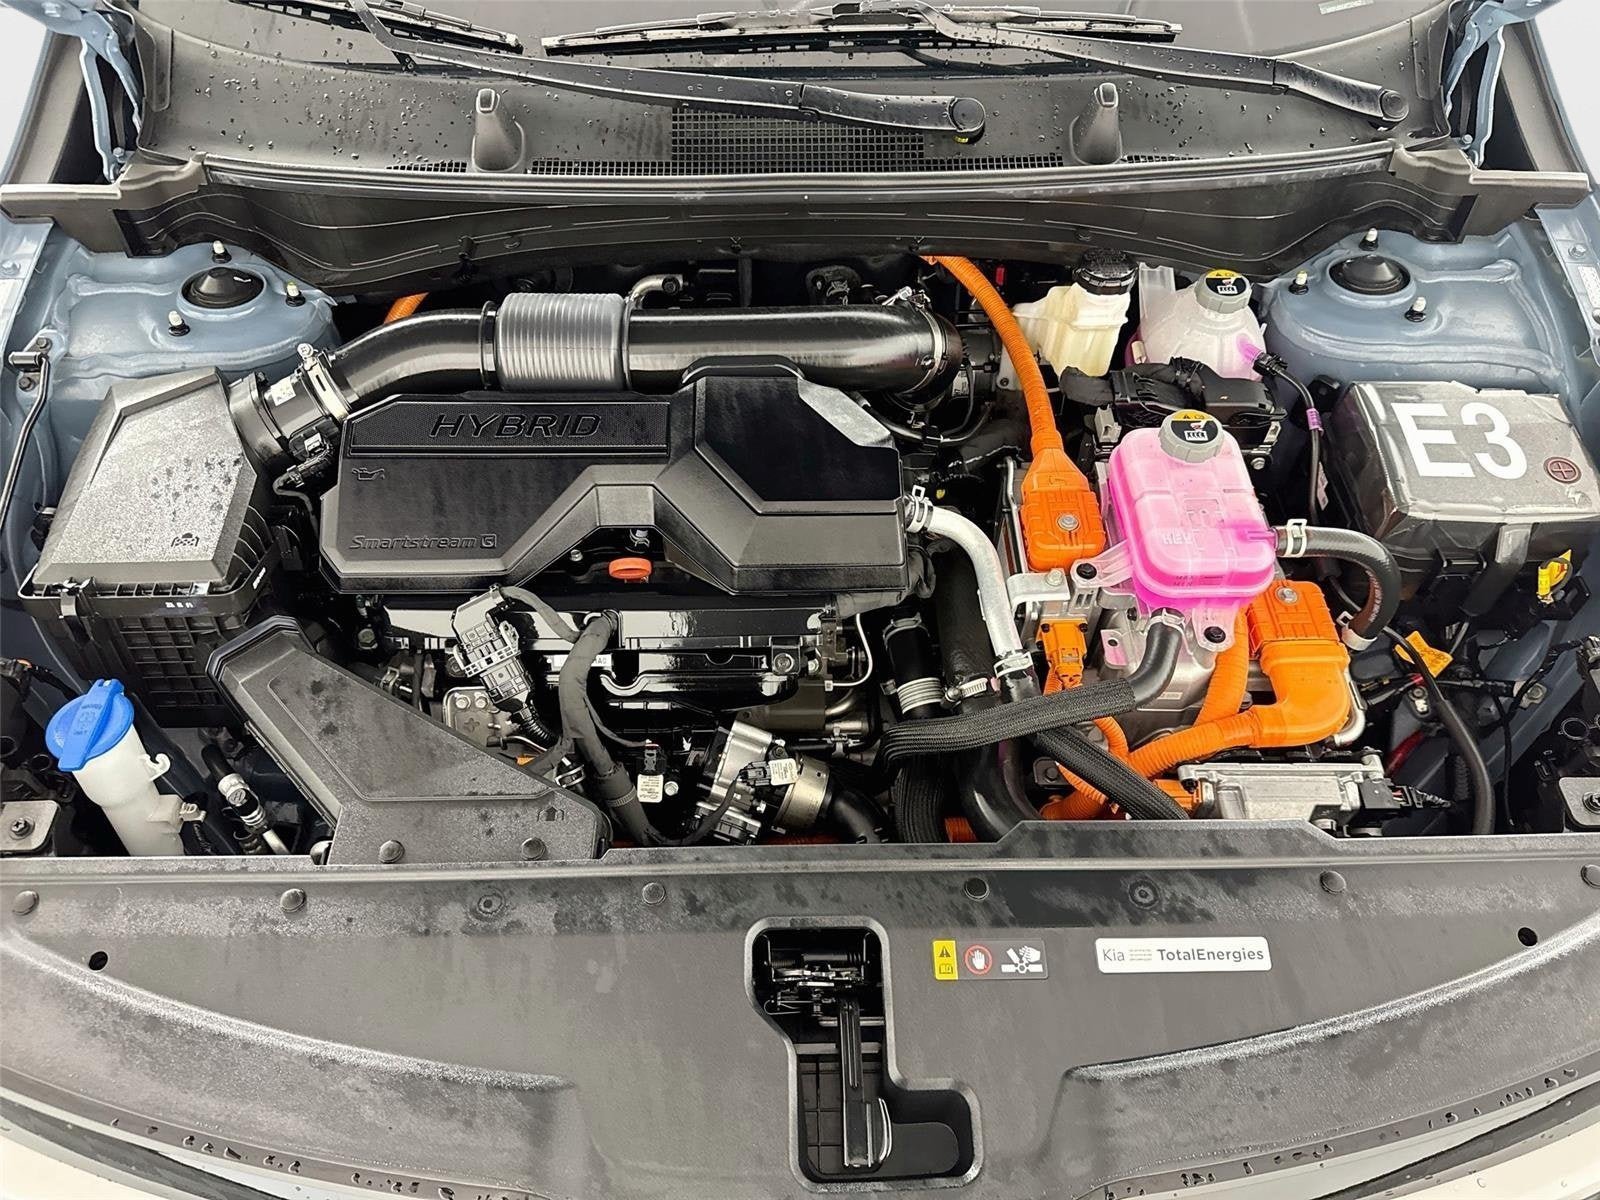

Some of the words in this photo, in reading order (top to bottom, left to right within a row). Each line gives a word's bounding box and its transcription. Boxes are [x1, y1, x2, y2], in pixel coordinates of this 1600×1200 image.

[429, 413, 601, 438] HYBRID
[1390, 401, 1528, 480] E3
[350, 535, 477, 550] Smartstream
[1102, 949, 1126, 962] Kia
[1157, 947, 1265, 963] TotalEnergies
